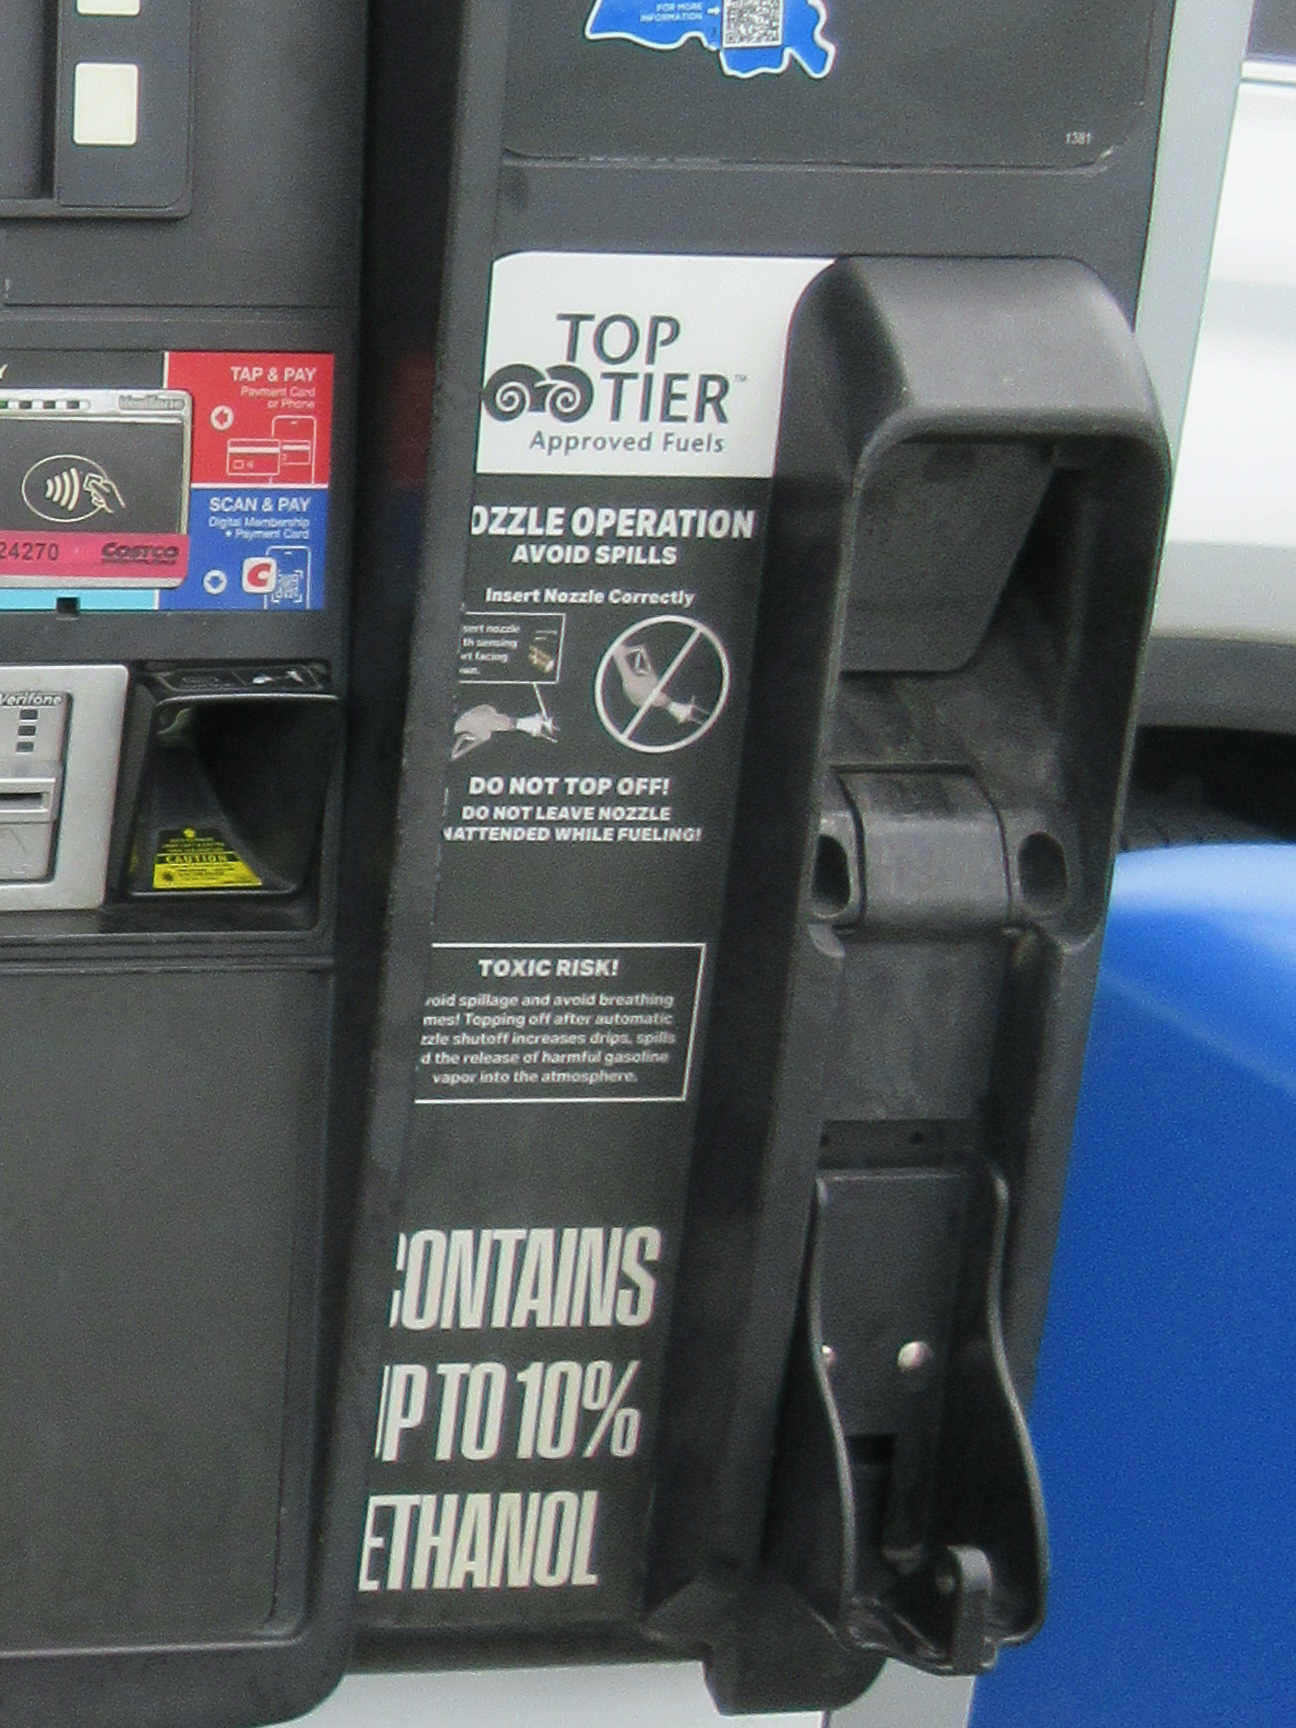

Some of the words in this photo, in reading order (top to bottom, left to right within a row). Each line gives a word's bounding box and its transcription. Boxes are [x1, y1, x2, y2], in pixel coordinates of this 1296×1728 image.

[556, 313, 682, 366] TOP
[230, 365, 264, 382] TAP
[266, 366, 279, 383] &
[283, 366, 316, 382] PAY
[600, 371, 731, 424] TIER
[529, 430, 653, 456] Approved
[662, 431, 725, 454] Fuels
[209, 496, 258, 513] SCAN
[261, 496, 274, 513] &
[277, 496, 311, 512] PAY
[471, 505, 566, 536] OZZLE
[571, 506, 754, 538] OPERATION
[99, 540, 181, 561] COSTCO
[512, 544, 591, 564] AVOID
[595, 545, 677, 565] SPILLS
[485, 587, 541, 603] Insert
[543, 588, 605, 604] Nozzle
[607, 588, 694, 607] Correctly
[469, 776, 505, 795] DO
[509, 776, 560, 795] NOT
[564, 777, 613, 796] TOP
[617, 777, 670, 796] OFF!
[435, 1361, 508, 1461] TO
[516, 1360, 640, 1459] 10%
[358, 1490, 598, 1591] ETHANOL
